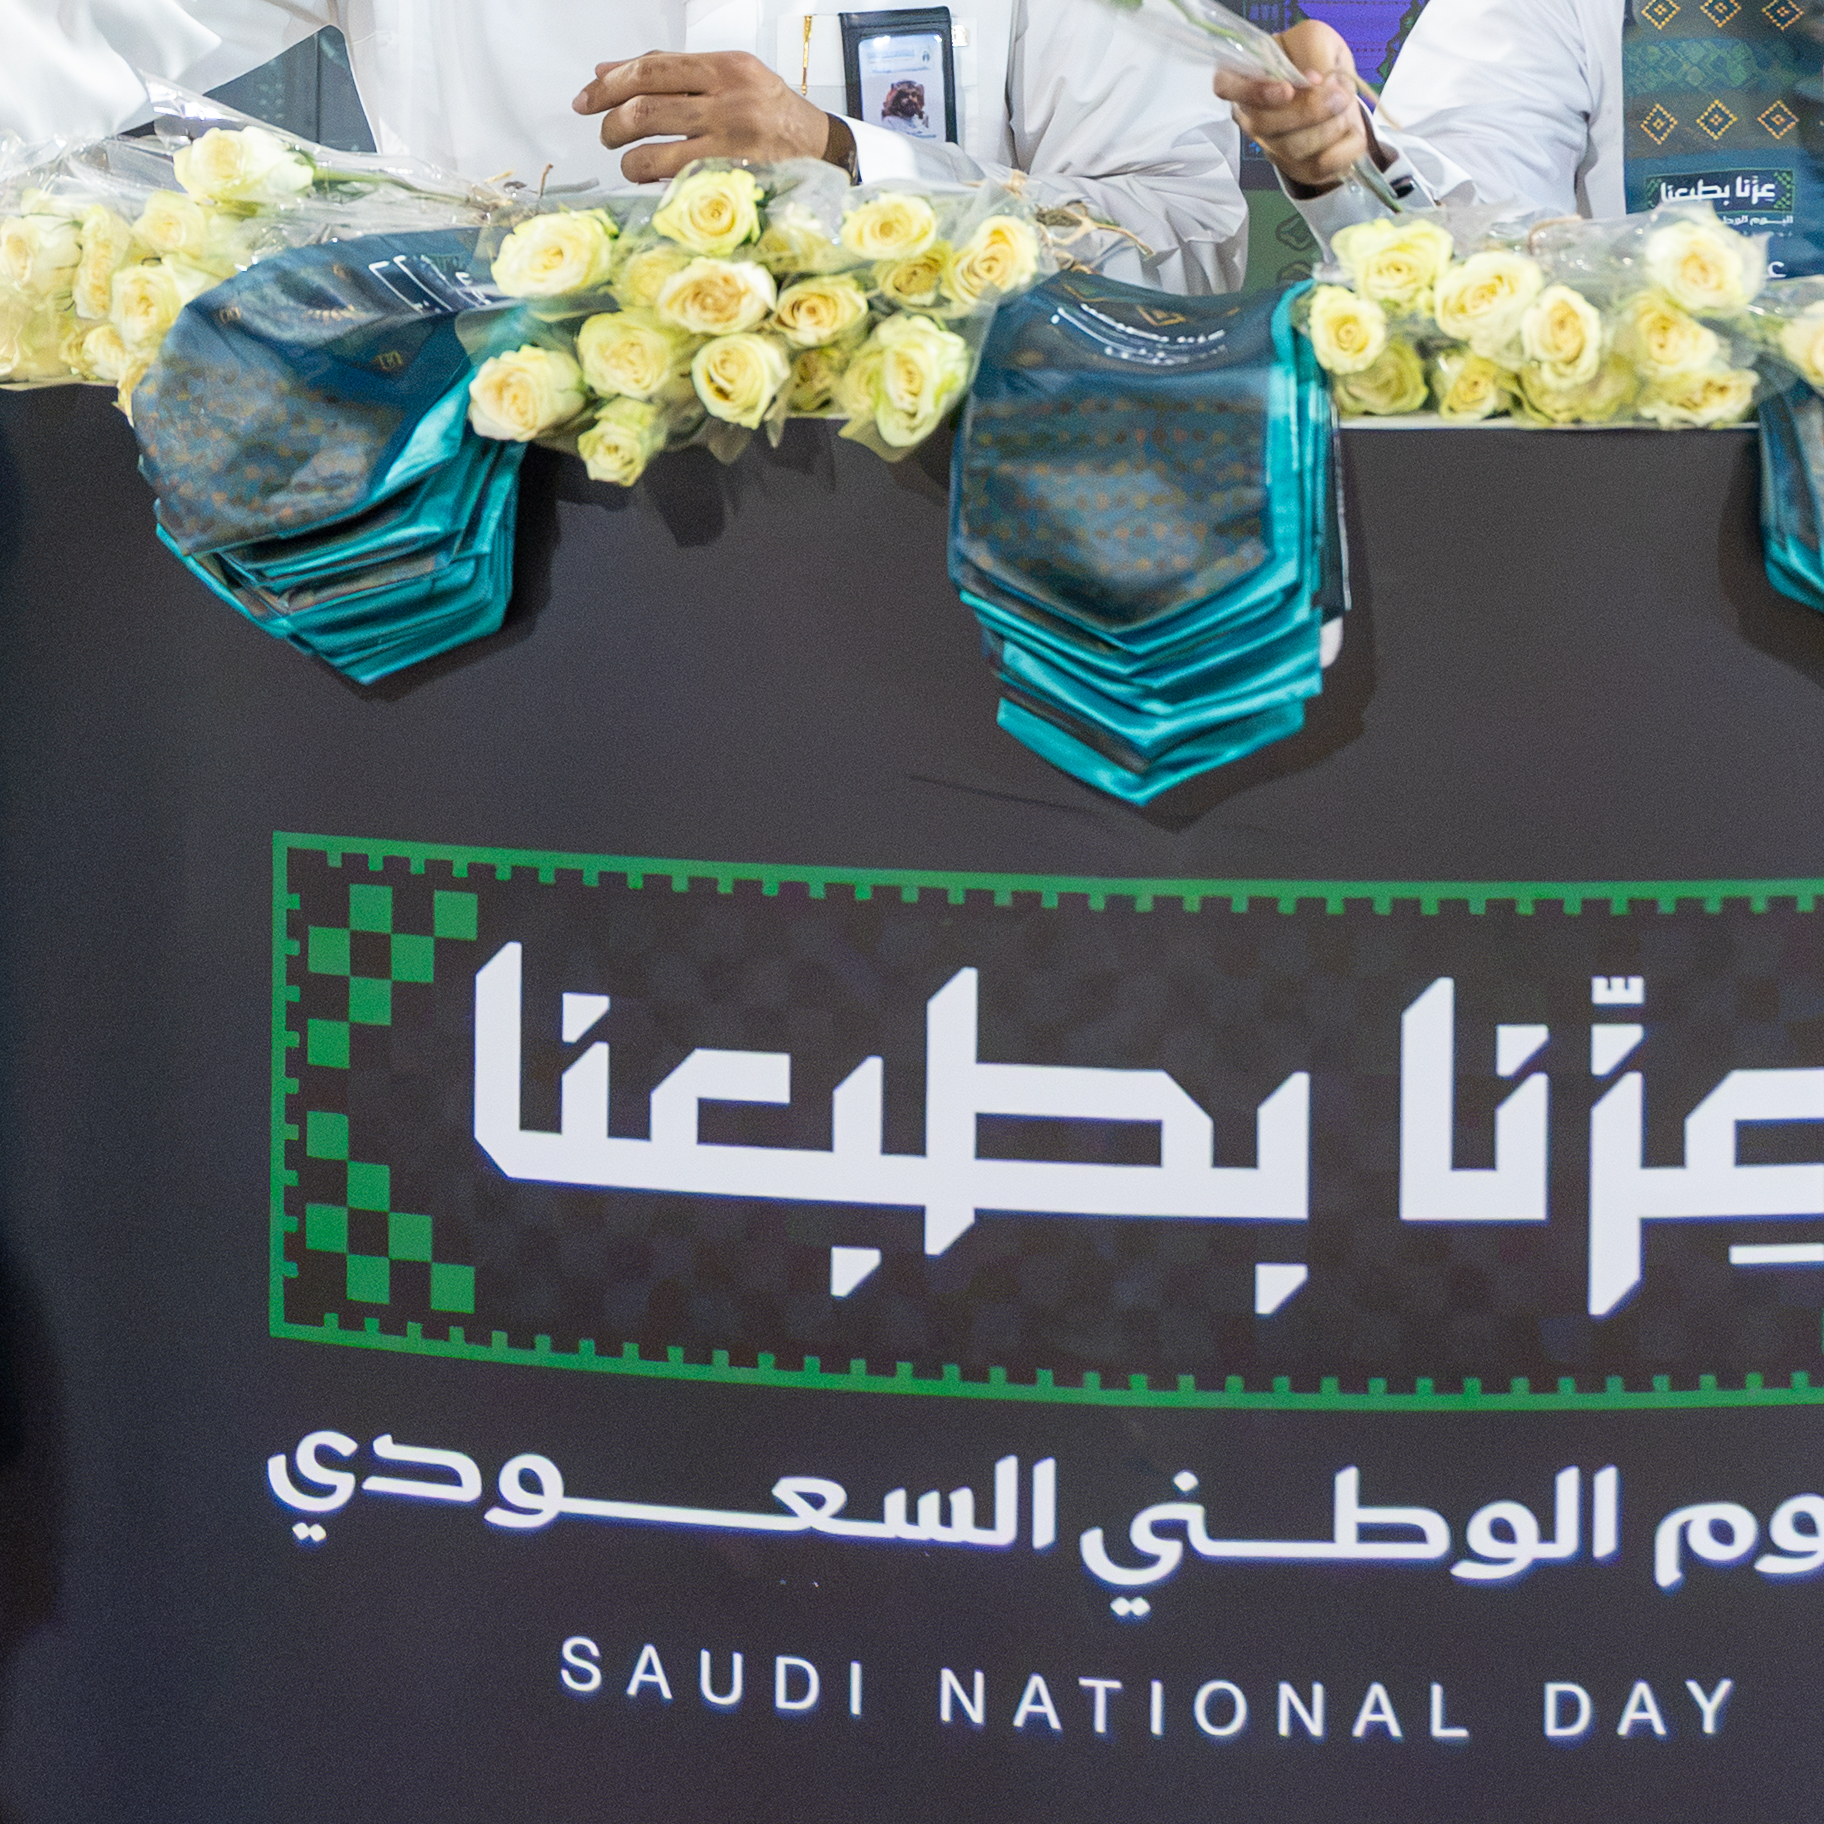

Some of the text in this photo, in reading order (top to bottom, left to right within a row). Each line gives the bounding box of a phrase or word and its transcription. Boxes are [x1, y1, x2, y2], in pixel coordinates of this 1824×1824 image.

[474, 942, 1310, 1315] بطبعنا
[267, 1430, 1057, 1550] السعودي
[1080, 1466, 1619, 1617] الوطني
[559, 1636, 1734, 1739] SAUDI NATIONAL DAY
